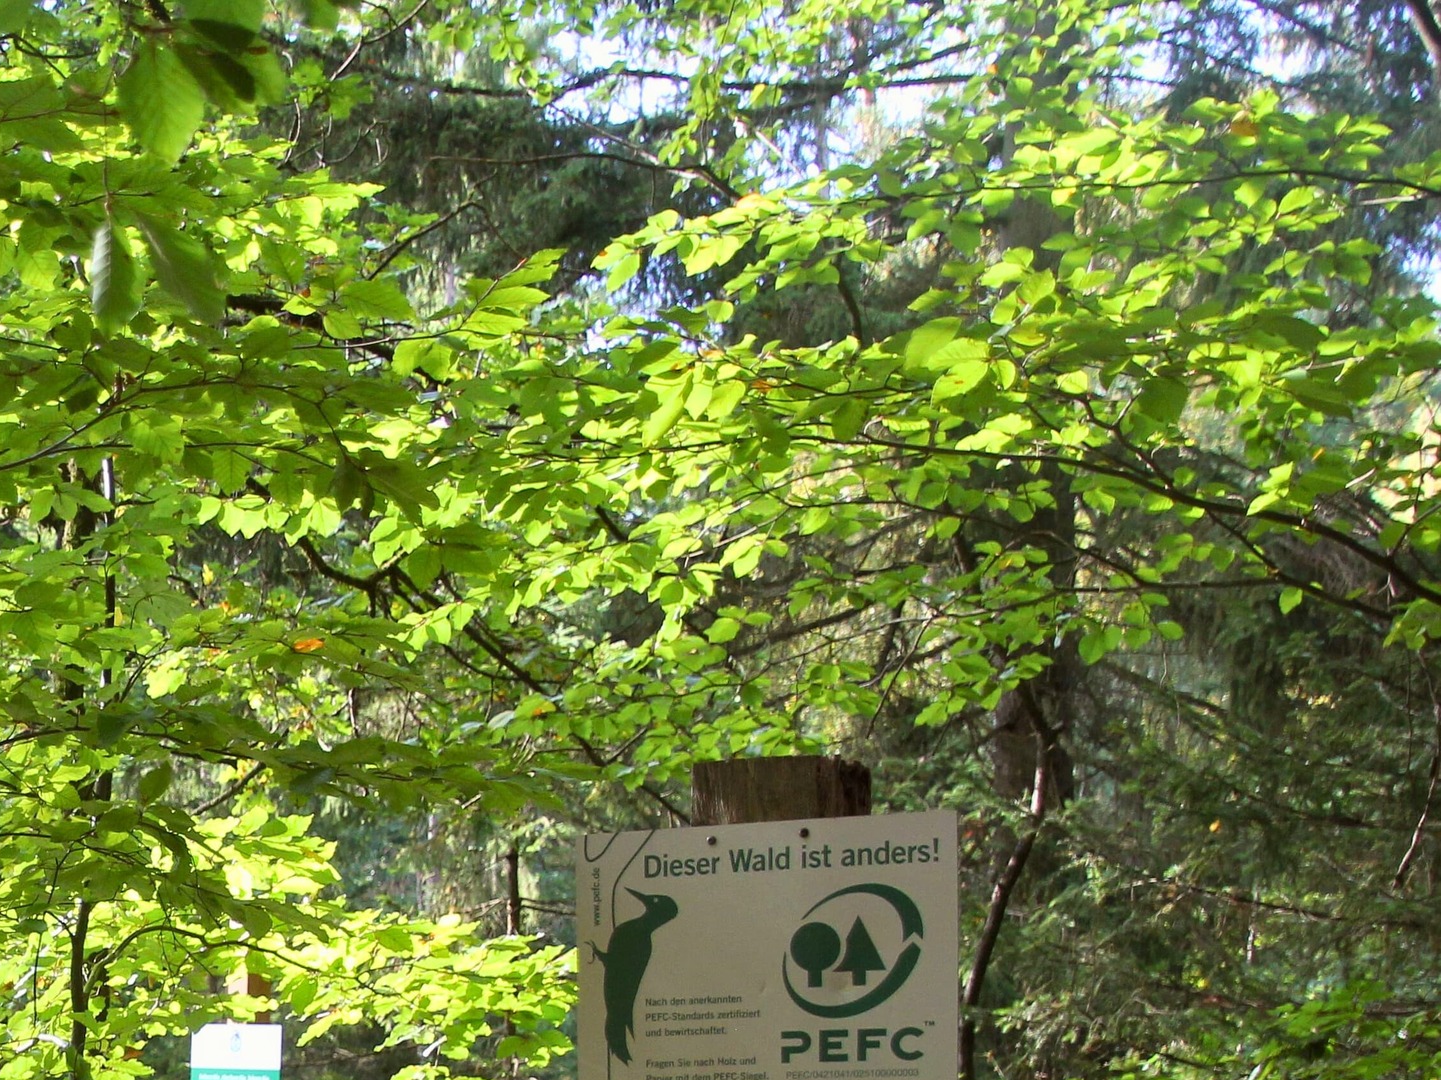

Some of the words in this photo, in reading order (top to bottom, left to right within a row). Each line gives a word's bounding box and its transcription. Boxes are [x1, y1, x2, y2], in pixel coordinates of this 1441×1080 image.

[644, 854, 720, 878] Dieser
[729, 846, 790, 873] Wald
[801, 845, 831, 869] ist
[841, 838, 939, 866] anders!
[591, 867, 602, 927] www.pefc.de
[645, 998, 667, 1007] Nach
[670, 997, 686, 1006] den
[689, 995, 742, 1005] anerkannten
[645, 1011, 715, 1021] PEFC-Standards
[717, 1009, 761, 1019] zertifiziert
[645, 1028, 662, 1037] und
[664, 1026, 727, 1036] bewirtschaftet.
[780, 1026, 924, 1064] PEFC
[645, 1059, 675, 1069] Fragen
[677, 1058, 691, 1067] Sie
[694, 1058, 715, 1067] nach
[717, 1056, 737, 1066] Holz
[740, 1056, 756, 1065] und
